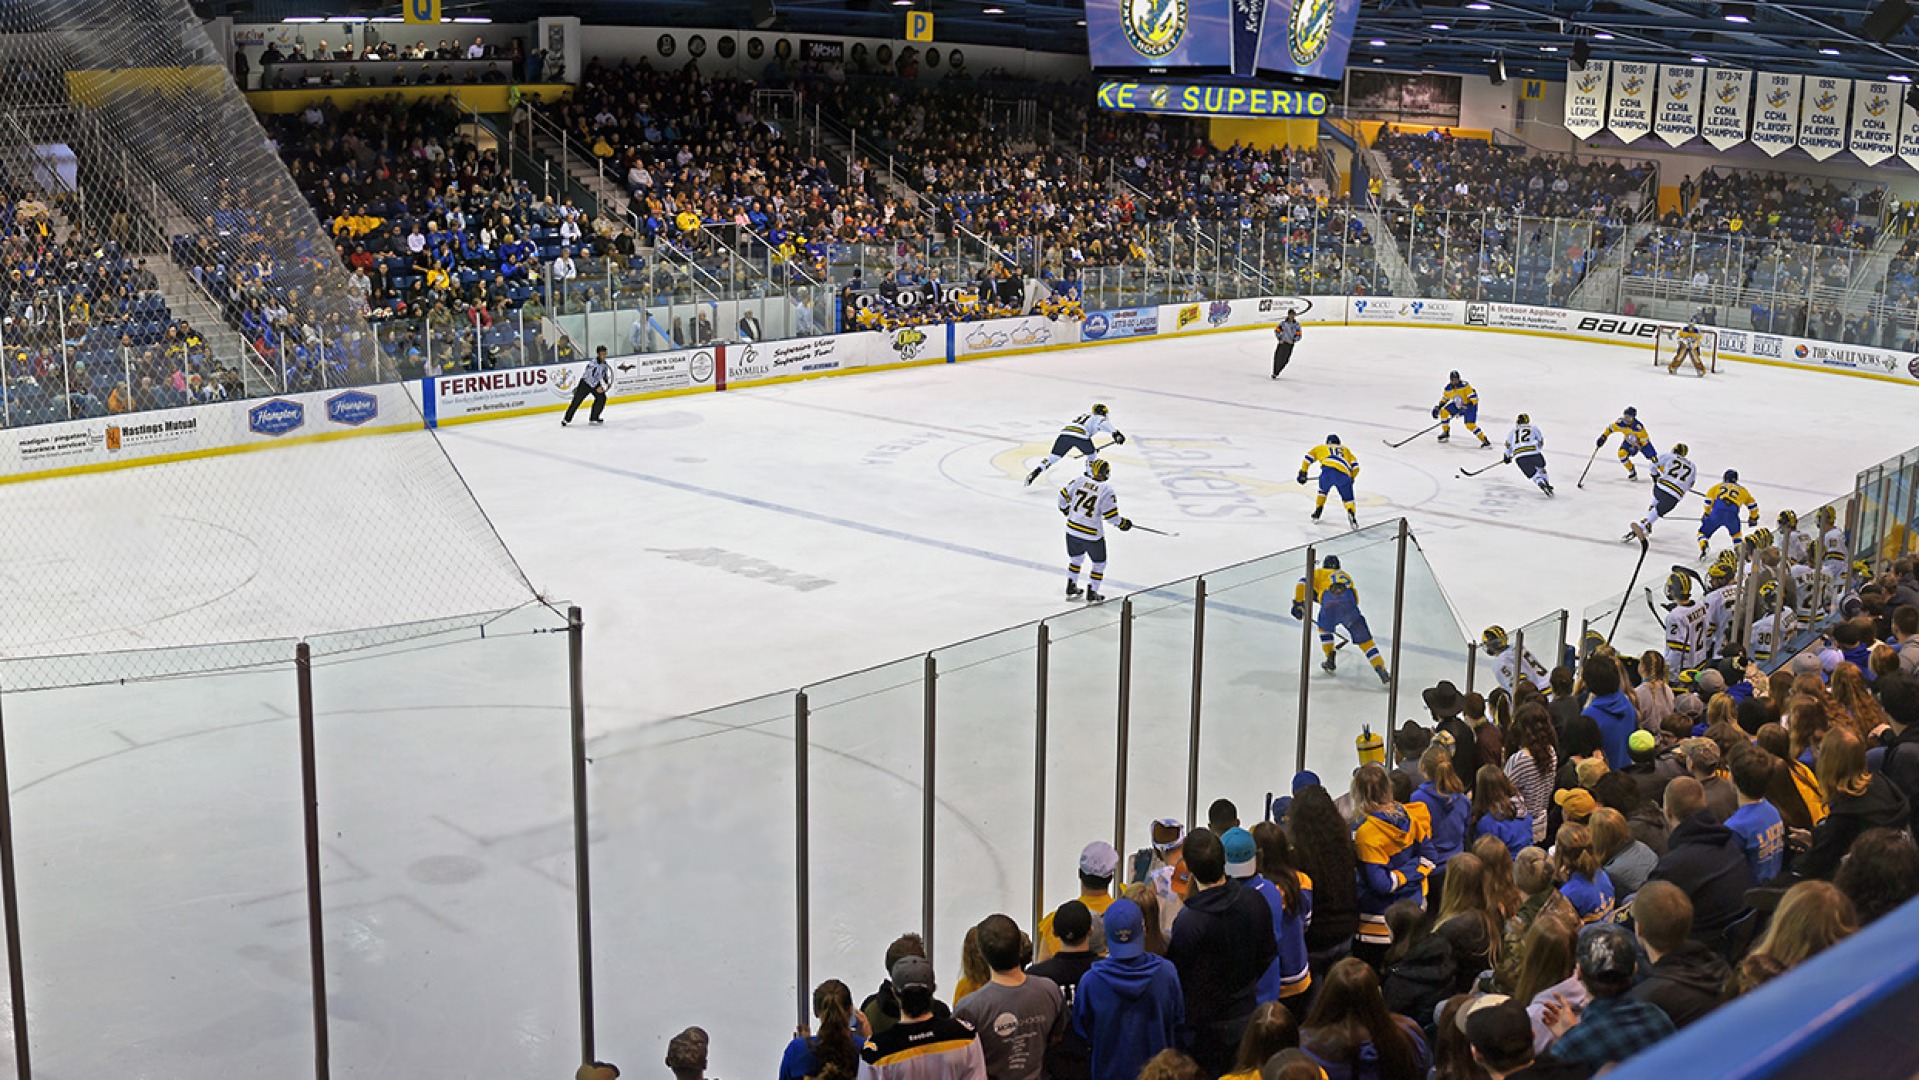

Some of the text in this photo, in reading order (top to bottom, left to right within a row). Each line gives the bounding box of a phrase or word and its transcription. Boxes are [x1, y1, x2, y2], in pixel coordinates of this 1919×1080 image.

[412, 0, 432, 20] Q
[914, 14, 926, 38] P
[1527, 81, 1541, 98] M
[1097, 83, 1327, 116] KE SUPERIO
[1574, 96, 1596, 105] CCHA
[1619, 98, 1641, 109] CCHA
[1571, 107, 1598, 118] LEAGUE
[1666, 102, 1689, 112] CCHA
[1714, 105, 1737, 117] CCHA
[1614, 108, 1647, 120] LEAGUE
[1660, 112, 1694, 124] LEAGUE
[1764, 110, 1787, 121] CCHA
[1811, 114, 1835, 126] CCHA
[1567, 118, 1600, 128] CHAMPION
[1610, 119, 1649, 131] CHAMPION
[1656, 123, 1697, 135] CHAMPION
[1707, 116, 1741, 129] LEAGUE
[1756, 121, 1792, 132] PLAYOFF
[1862, 118, 1886, 131] CCHA
[1702, 127, 1744, 140] CHAMPION
[1803, 124, 1841, 137] PLAYOFF
[1853, 129, 1892, 142] PLAYOFF
[1753, 132, 1795, 144] CHAMPION
[1800, 136, 1842, 149] CHAMPION
[1850, 141, 1894, 154] CHAMPION
[1529, 308, 1568, 319] Appliance
[773, 343, 811, 358] Superior
[772, 353, 811, 368] Superior
[1857, 352, 1881, 367] NEWS
[440, 369, 548, 396] FERNELIUS
[121, 418, 197, 437] Hastings Mutual
[1514, 428, 1531, 444] 12
[1667, 459, 1692, 482] 27
[1074, 488, 1098, 518] 74
[1670, 623, 1679, 635] 2
[1757, 632, 1772, 646] 30
